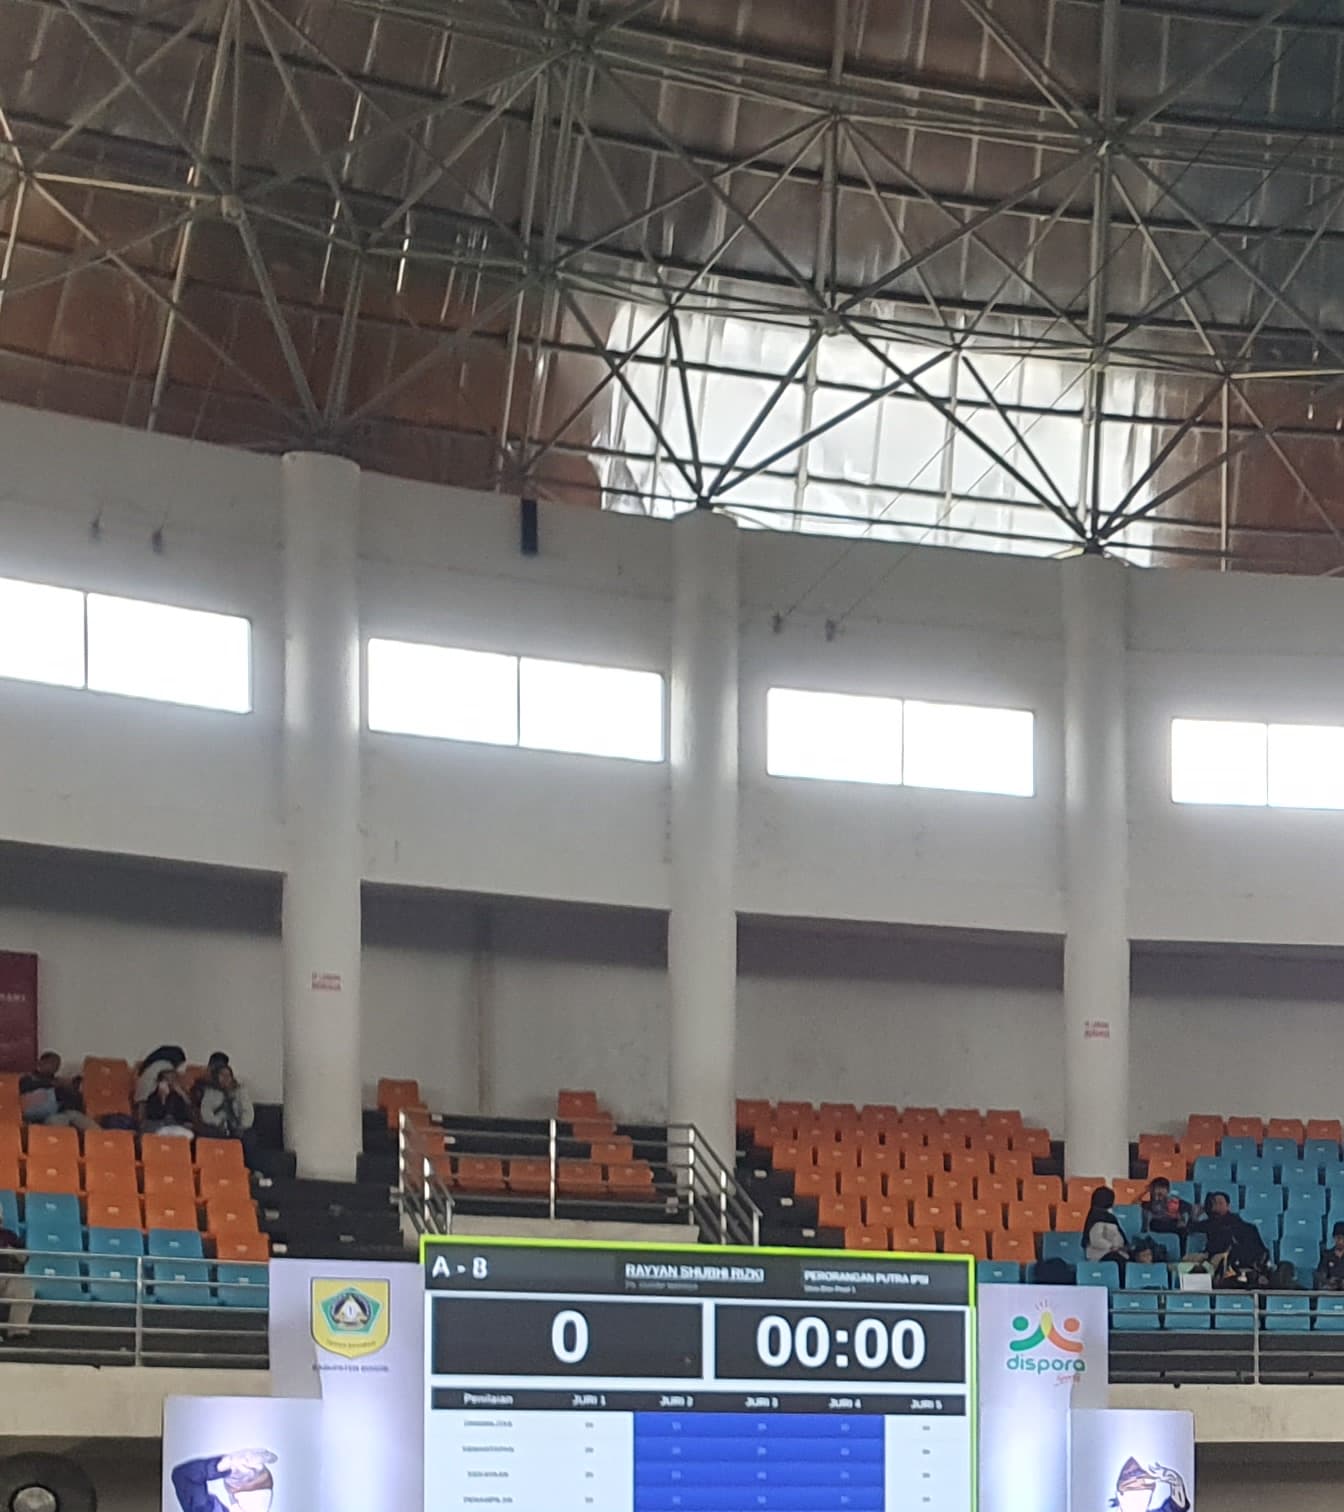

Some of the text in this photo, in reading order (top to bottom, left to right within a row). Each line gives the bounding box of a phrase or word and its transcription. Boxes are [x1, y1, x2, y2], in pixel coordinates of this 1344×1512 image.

[432, 1256, 450, 1278] A
[472, 1257, 488, 1279] B
[625, 1263, 677, 1279] RAYYAN
[551, 1309, 589, 1364] 0
[757, 1315, 926, 1370] 00:00
[1006, 1354, 1086, 1374] dispora
[463, 1392, 514, 1405] Penilaian
[572, 1394, 598, 1406] JURI
